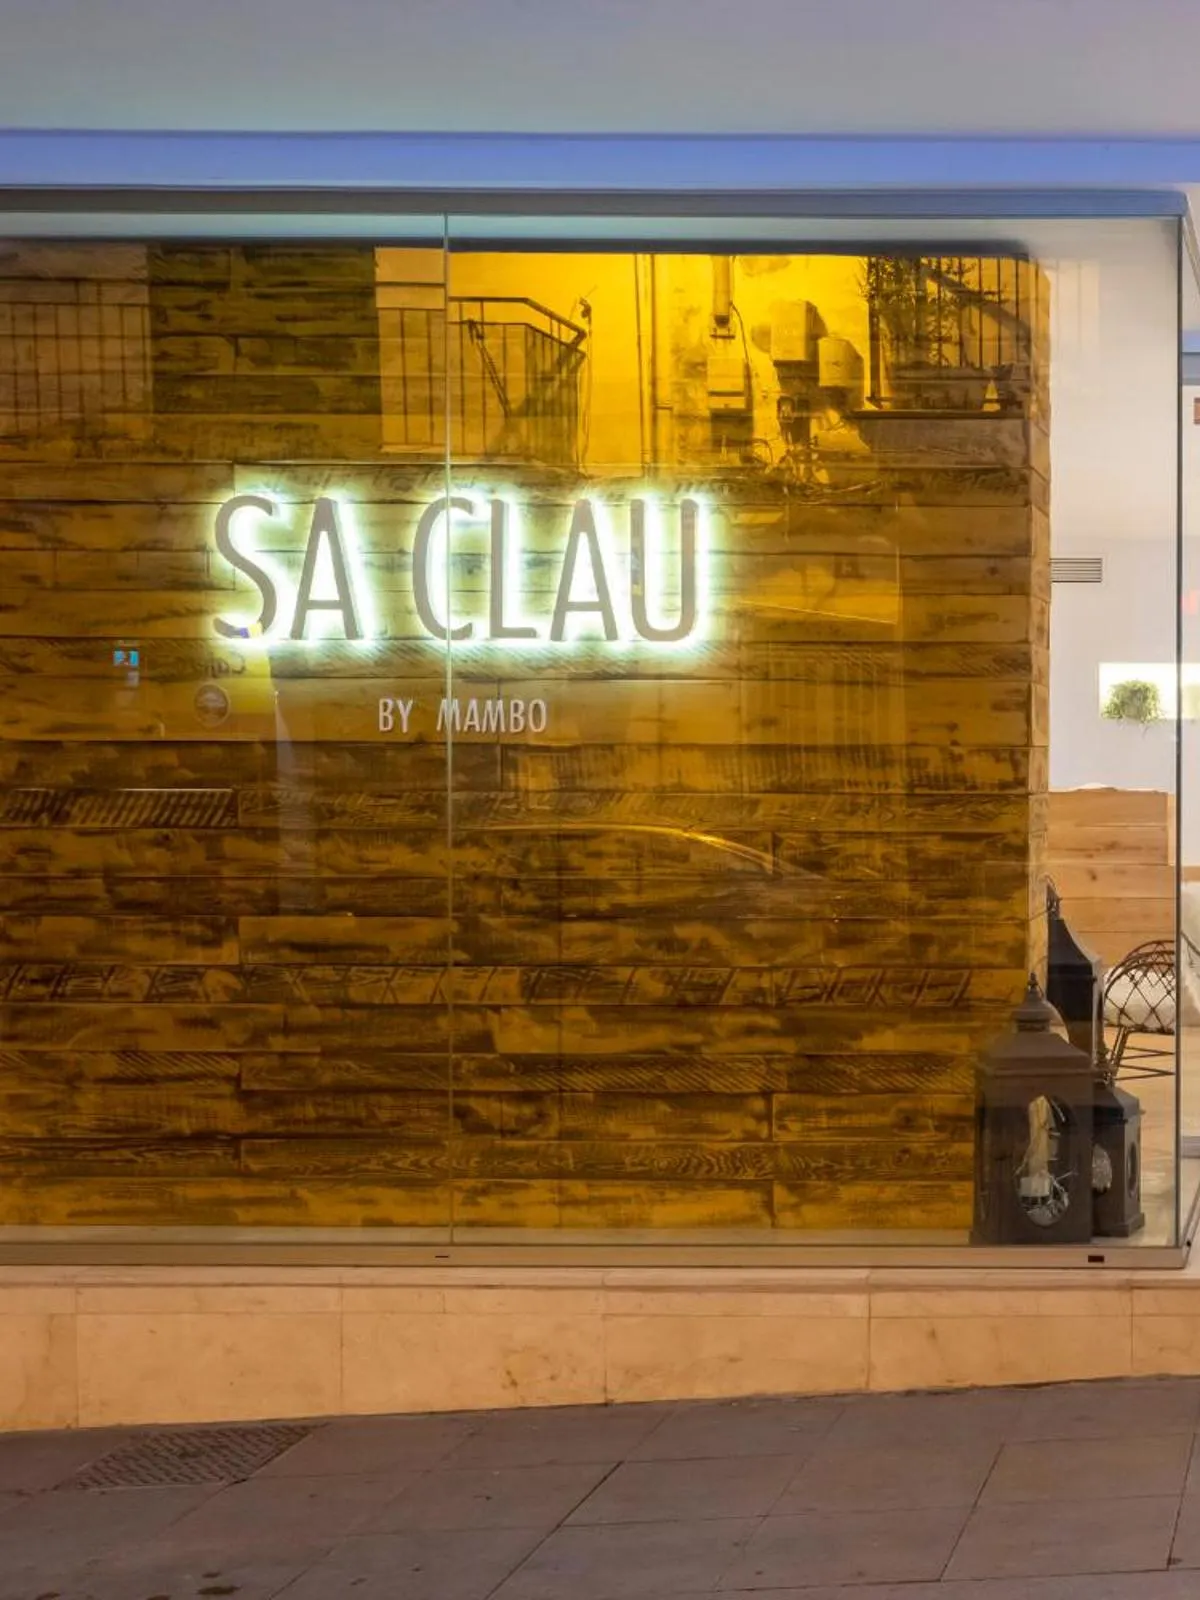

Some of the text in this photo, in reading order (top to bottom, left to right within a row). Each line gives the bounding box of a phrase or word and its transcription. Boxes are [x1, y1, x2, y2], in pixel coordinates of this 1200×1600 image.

[212, 494, 701, 642] SA CLAU
[378, 697, 548, 734] BY MAMBO
